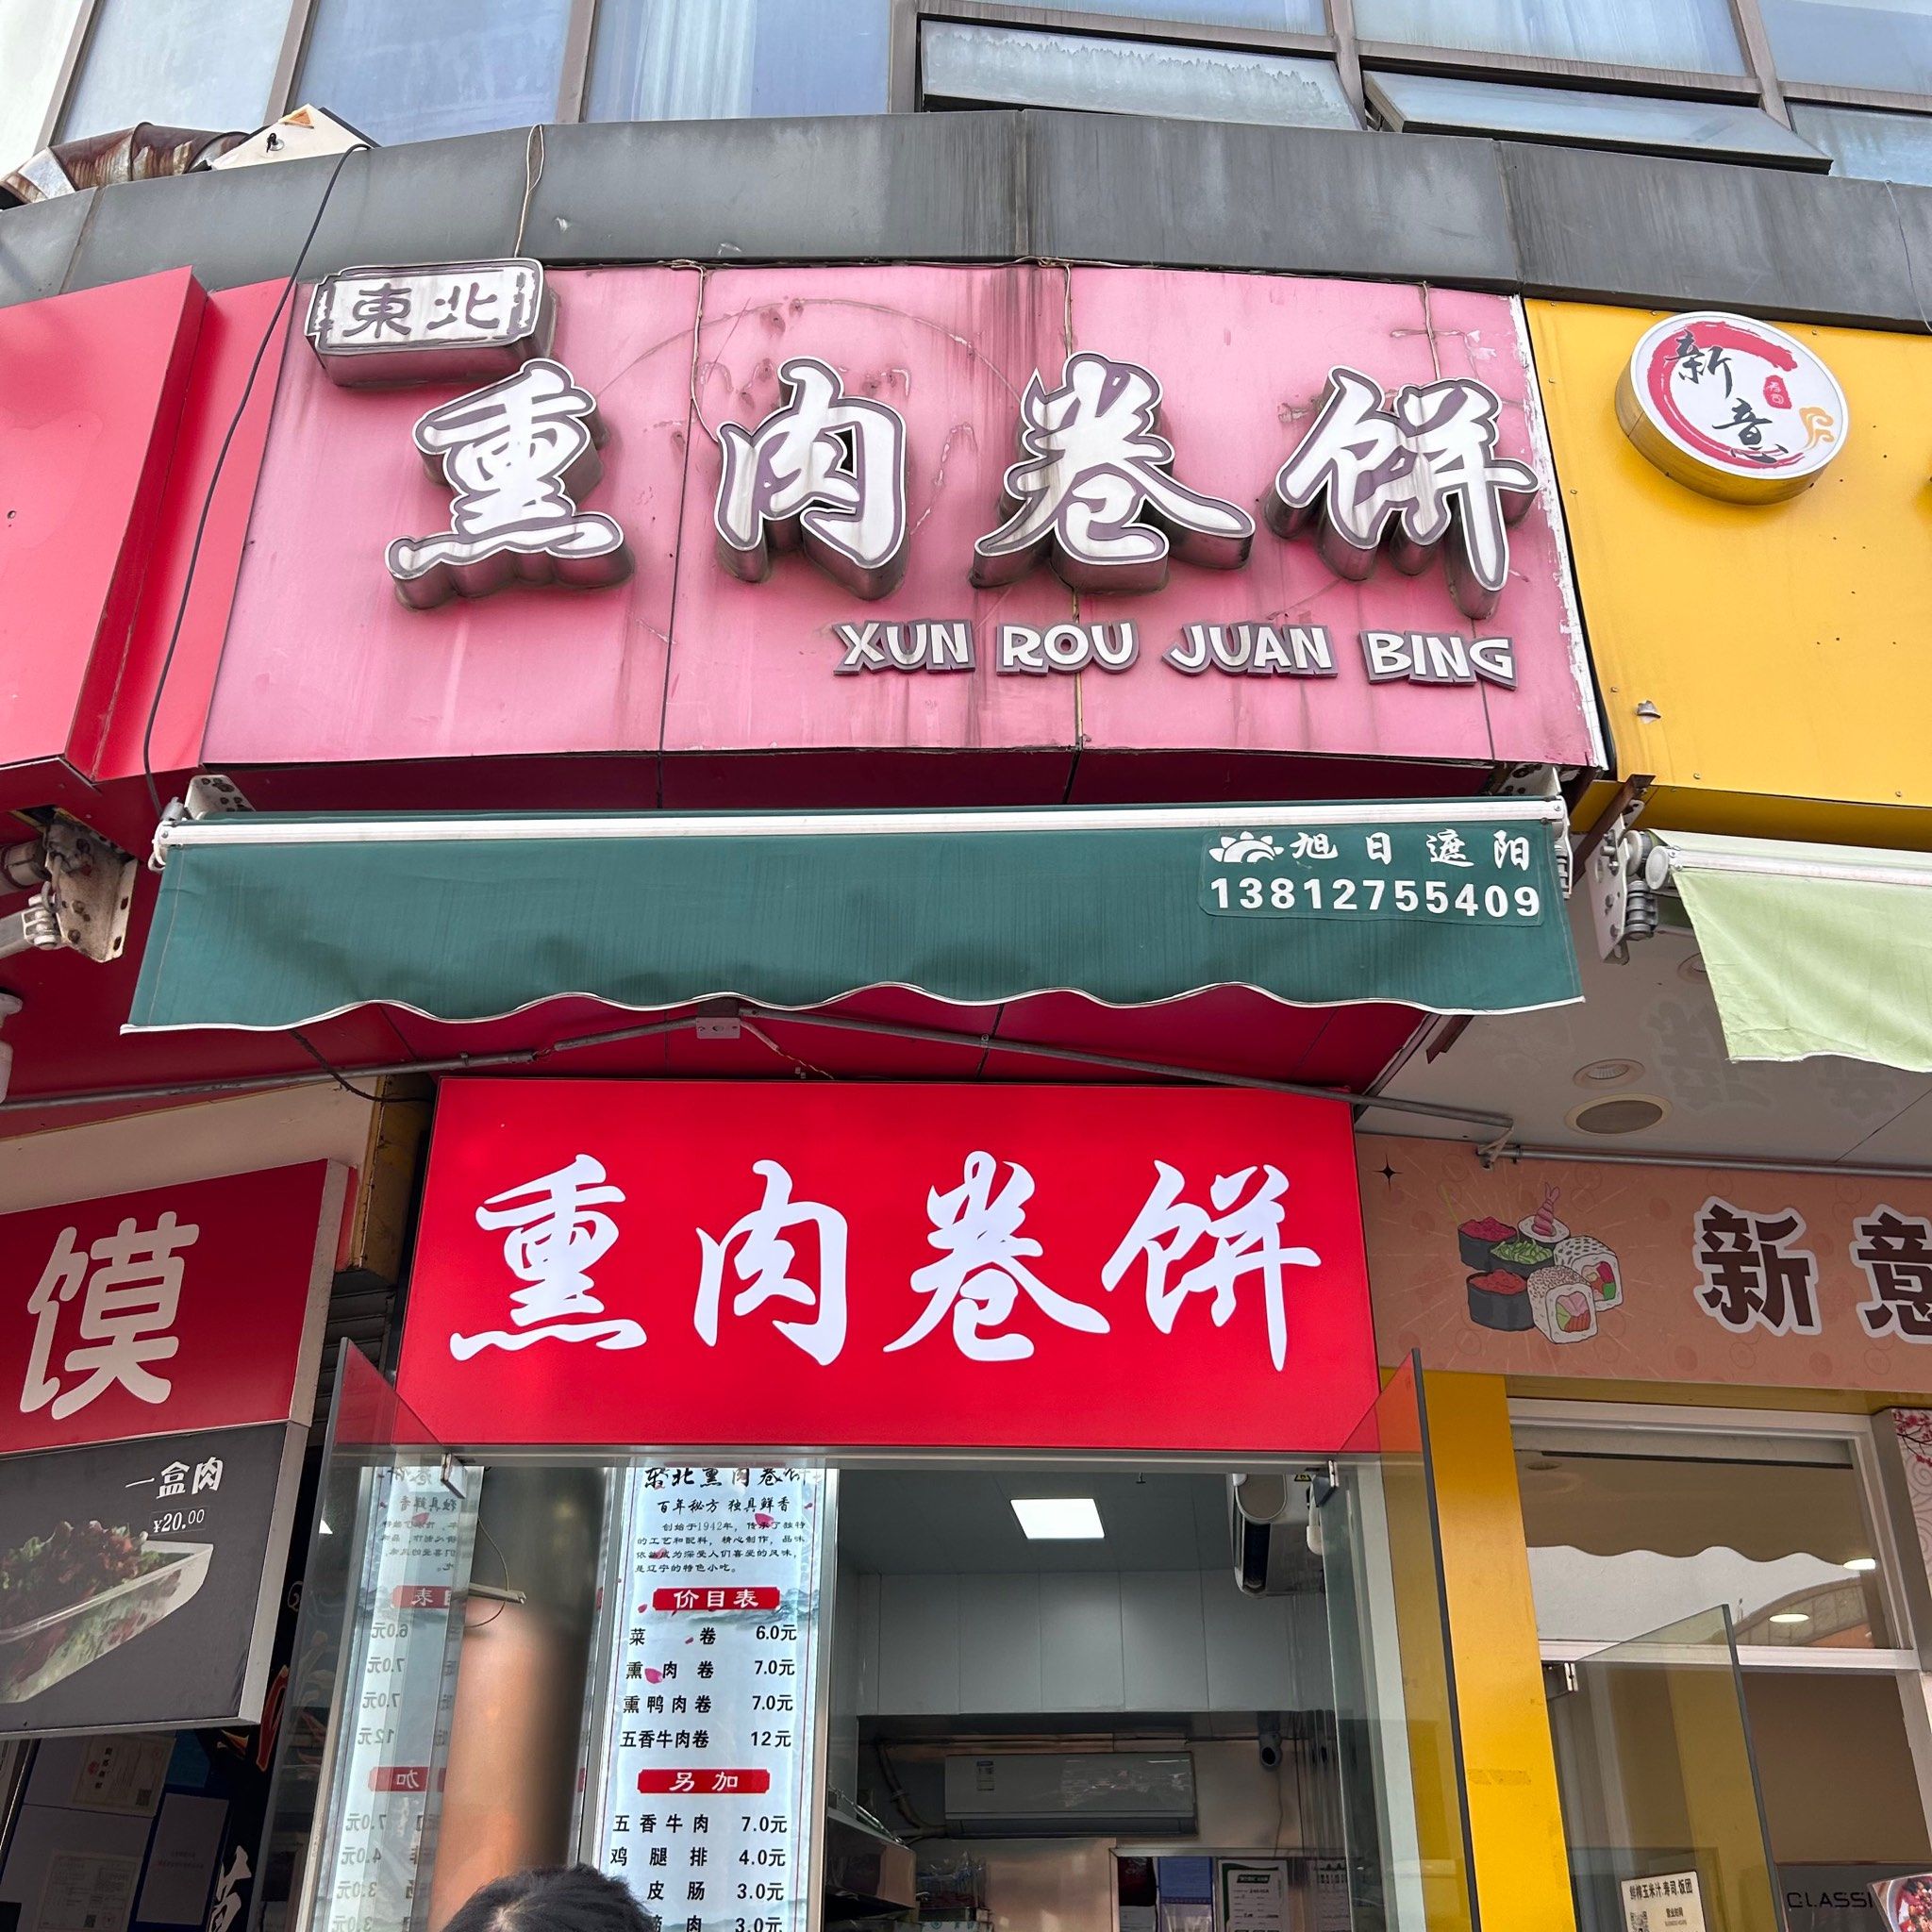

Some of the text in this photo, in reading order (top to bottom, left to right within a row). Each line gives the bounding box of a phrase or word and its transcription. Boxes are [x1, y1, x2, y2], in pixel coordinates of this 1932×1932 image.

[341, 282, 501, 338] 東北
[1665, 328, 1789, 464] 新意
[836, 621, 1514, 680] XUN ROU JUAN BING
[1290, 828, 1529, 871] 旭日遮阳
[1210, 877, 1540, 918] 13812755409
[1696, 1198, 1932, 1341] 新意
[20, 1211, 200, 1421] 馍
[125, 1456, 224, 1500] 一盒肉
[153, 1508, 206, 1534] ¥20.00
[673, 1589, 758, 1609] 价目表
[755, 1624, 797, 1642] 6.0元
[754, 1658, 795, 1677] 7.0元
[752, 1694, 793, 1712] 7.0元
[619, 1729, 792, 1748] 五香牛肉卷 12元
[669, 1771, 739, 1791] 另加
[612, 1813, 788, 1834] 五香牛肉 7.0元
[739, 1848, 787, 1867] 4.0元
[737, 1882, 785, 1901] 3.0元
